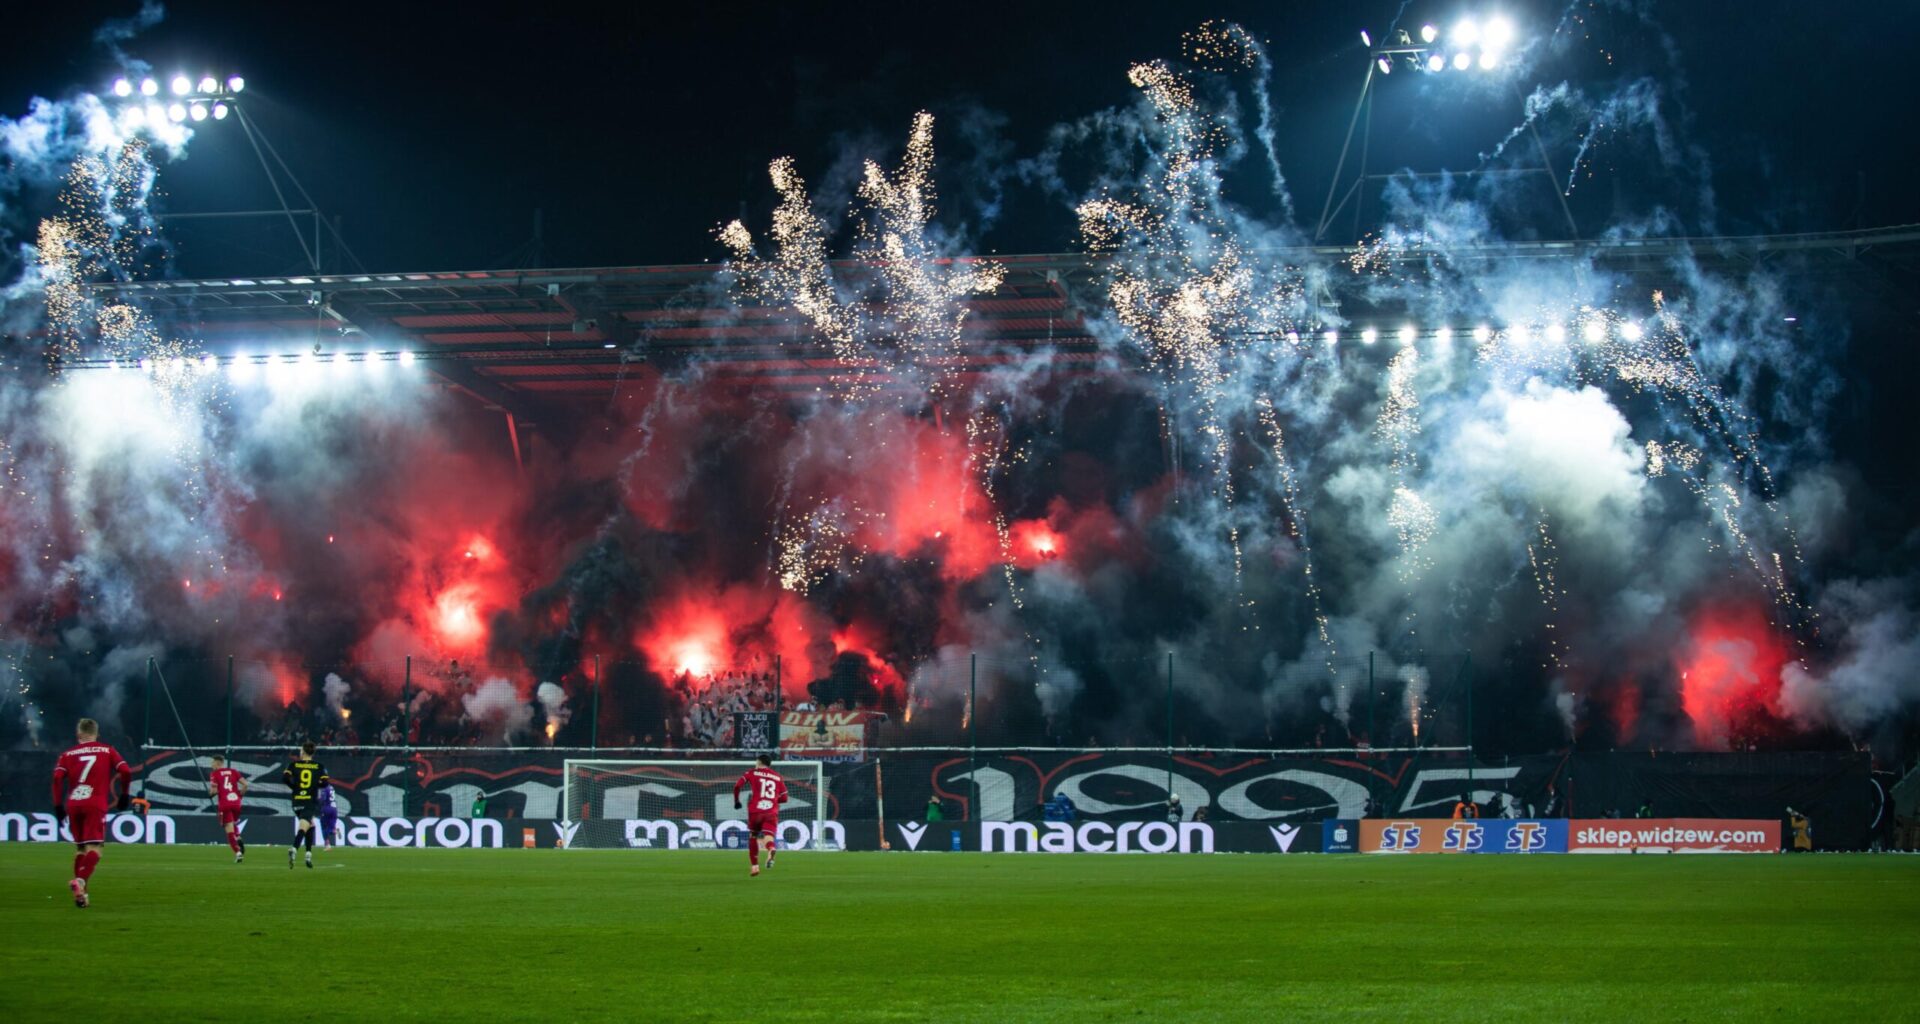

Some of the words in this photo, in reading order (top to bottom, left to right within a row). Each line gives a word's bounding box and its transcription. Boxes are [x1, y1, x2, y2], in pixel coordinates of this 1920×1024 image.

[743, 713, 768, 721] ZAJCU
[782, 711, 860, 726] DHW
[79, 755, 97, 783] 7
[300, 769, 312, 788] 9
[223, 776, 232, 791] 4
[760, 778, 776, 799] 13
[946, 764, 1534, 820] 1995
[981, 821, 1214, 853] macron
[1380, 822, 1421, 850] STS
[1442, 822, 1484, 850] STS
[1505, 822, 1547, 850] STS
[1576, 827, 1766, 847] sklep.widzew.com
